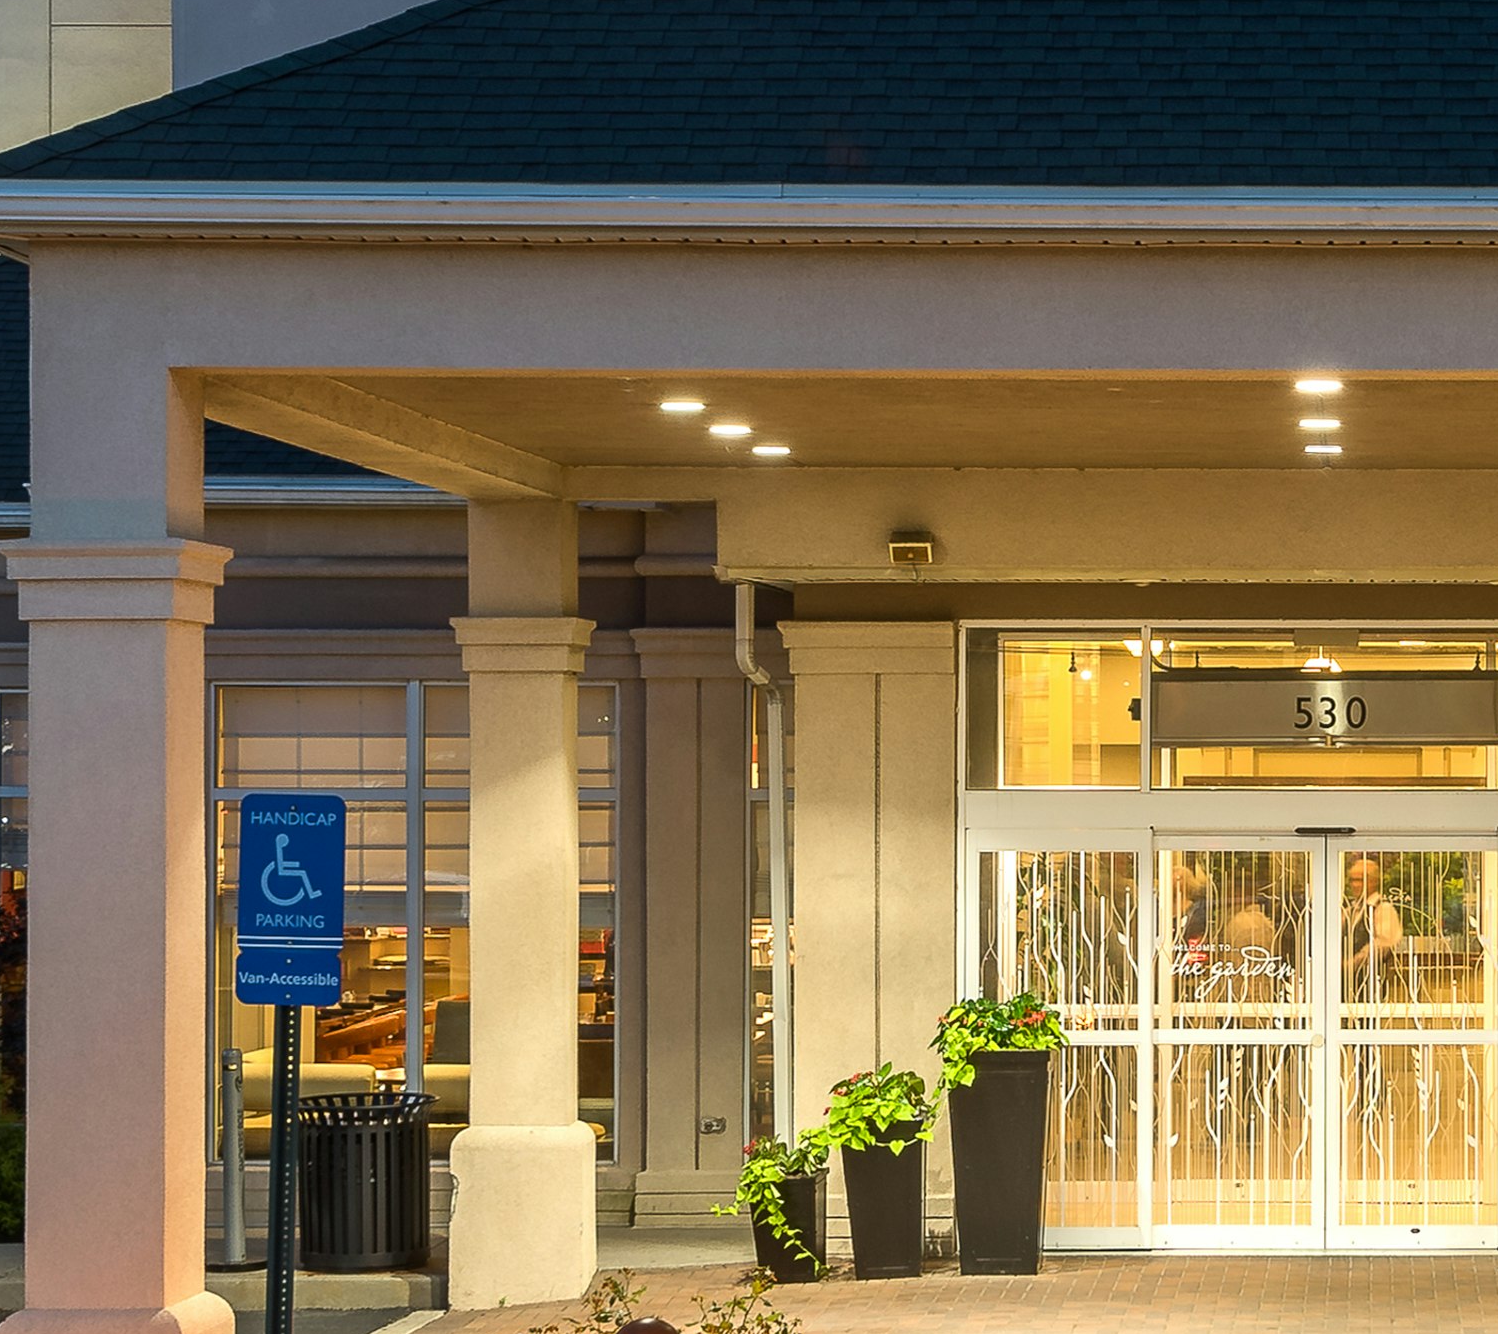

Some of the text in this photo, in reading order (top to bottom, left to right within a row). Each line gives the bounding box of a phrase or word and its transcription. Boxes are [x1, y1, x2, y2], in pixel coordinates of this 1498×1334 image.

[1293, 696, 1367, 729] 530
[250, 811, 337, 826] HANDICAP
[255, 913, 325, 929] PARKING
[238, 971, 339, 986] Van-Accessible
[1171, 946, 1295, 1001] the garden
